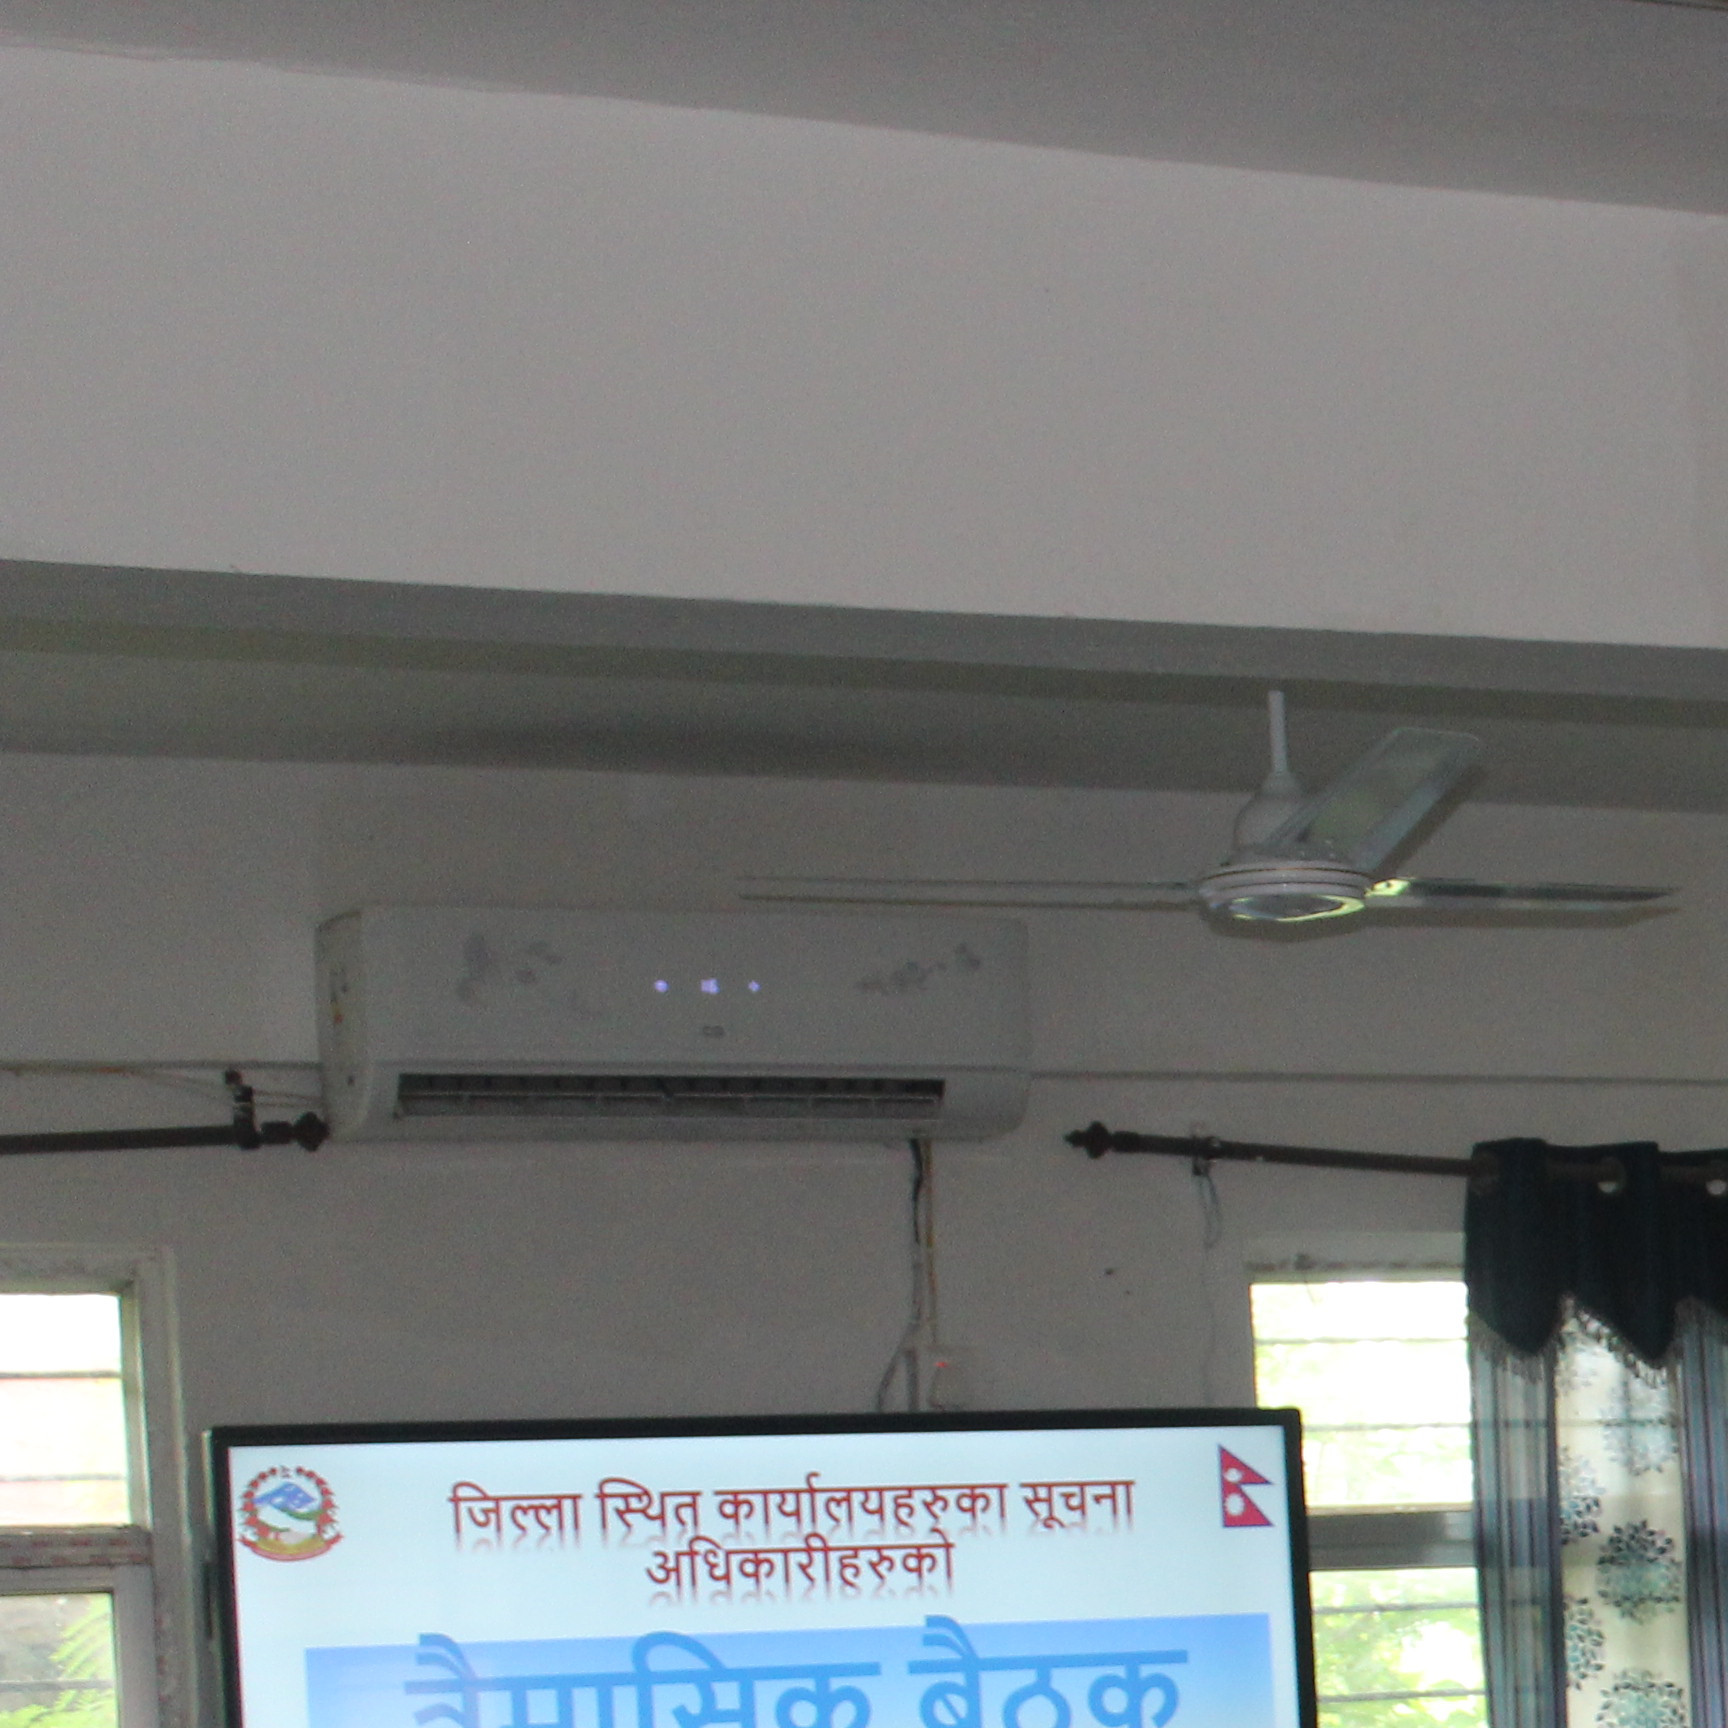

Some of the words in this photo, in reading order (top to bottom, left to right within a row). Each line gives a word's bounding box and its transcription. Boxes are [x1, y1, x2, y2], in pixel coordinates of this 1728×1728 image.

[448, 1481, 583, 1534] जिल्ला
[595, 1477, 703, 1531] स्थित
[713, 1471, 1009, 1531] कार्यालयहरुका
[1018, 1480, 1136, 1529] सूचना
[646, 1528, 956, 1590] अधिकारीहरुको
